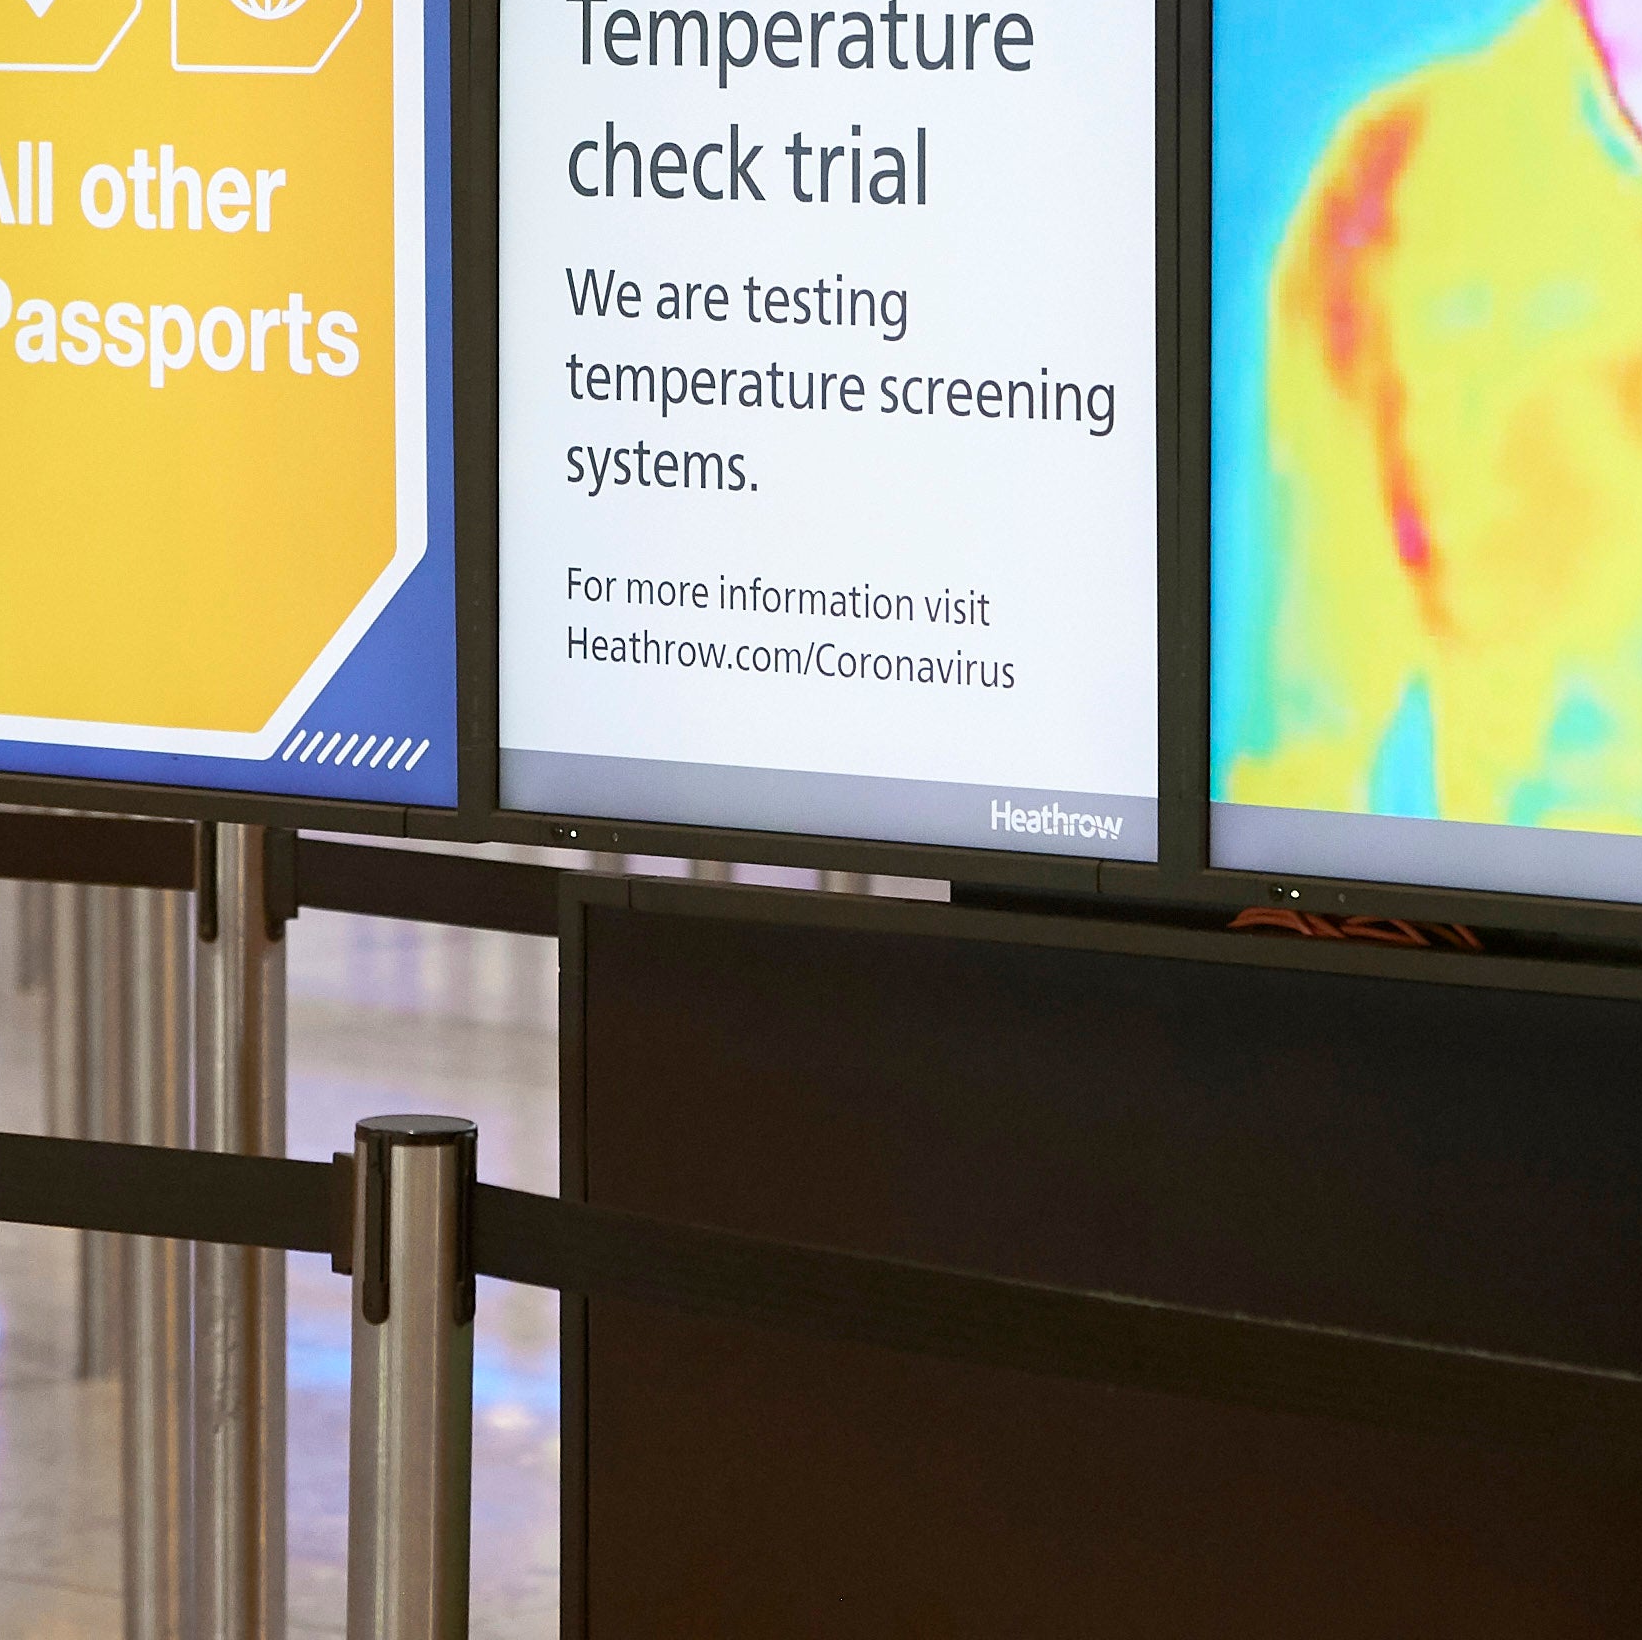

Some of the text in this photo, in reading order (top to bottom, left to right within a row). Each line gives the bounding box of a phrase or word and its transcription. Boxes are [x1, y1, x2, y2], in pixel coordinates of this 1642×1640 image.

[79, 144, 286, 233] other
[568, 121, 927, 205] check trial
[566, 268, 907, 341] We are testing
[566, 354, 1115, 436] temperature screening
[567, 440, 758, 497] systems.
[567, 567, 990, 627] For more information visit
[567, 625, 1016, 689] Heathrow.com/Coronavirus
[991, 799, 1124, 840] Heathrow
